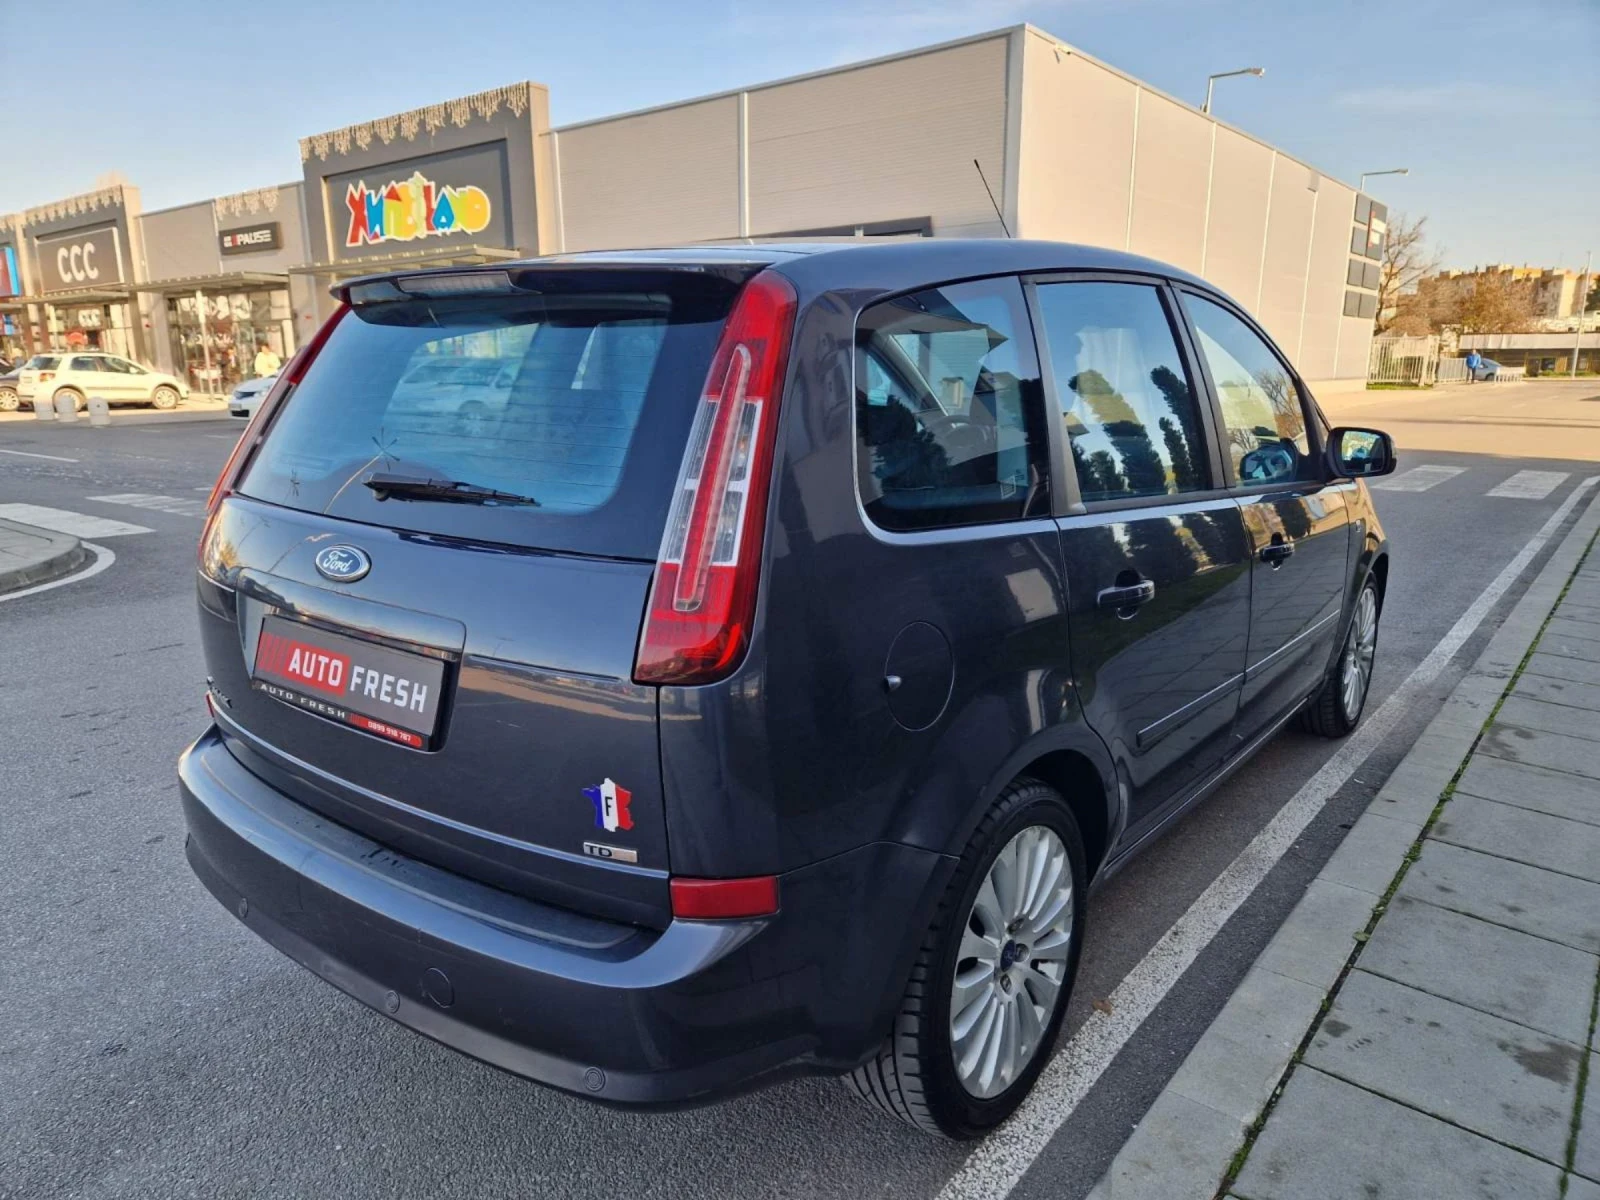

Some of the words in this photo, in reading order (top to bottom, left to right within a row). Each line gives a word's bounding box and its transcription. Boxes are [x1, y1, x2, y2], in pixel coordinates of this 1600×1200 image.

[236, 229, 272, 246] PAUSE
[57, 242, 99, 283] CCC
[322, 550, 353, 573] Ford
[288, 648, 344, 687] AUTO
[349, 665, 428, 713] FRESH
[260, 683, 294, 700] AUTO
[300, 697, 346, 719] FRESH
[605, 796, 613, 816] F
